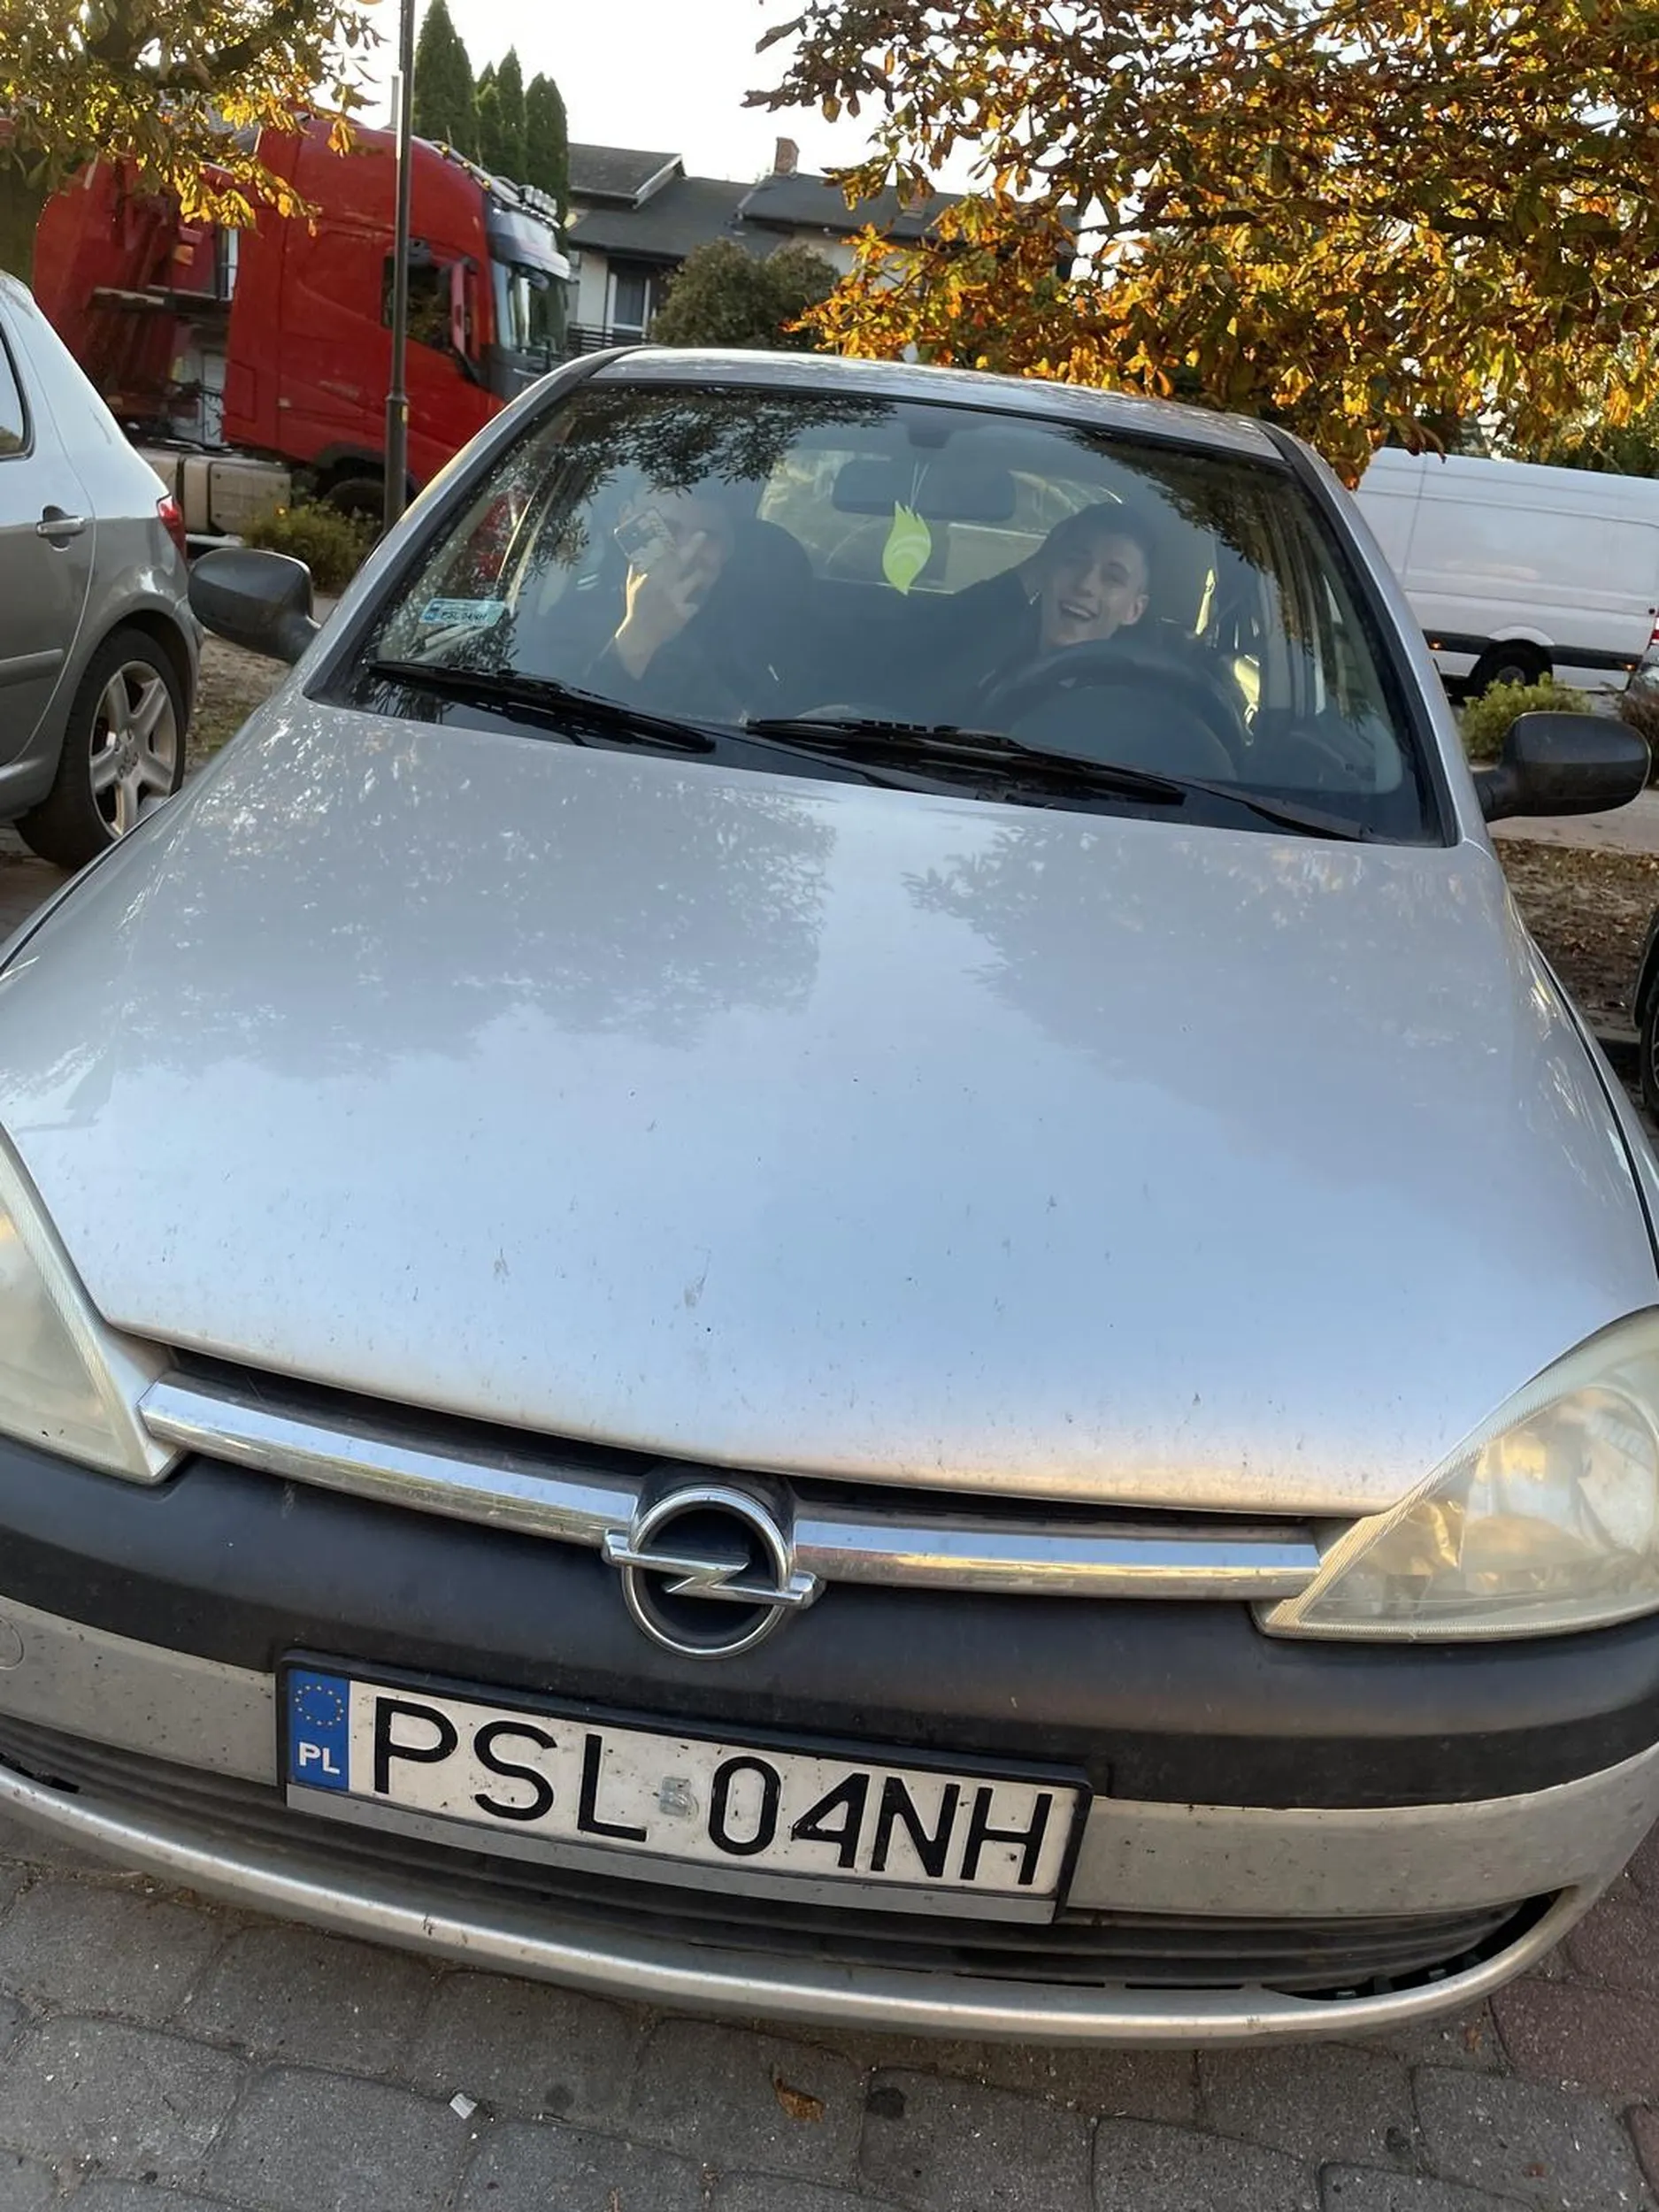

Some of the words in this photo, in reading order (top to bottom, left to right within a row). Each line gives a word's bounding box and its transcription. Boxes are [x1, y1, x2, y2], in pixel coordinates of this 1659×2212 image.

[298, 1742, 340, 1774] PL
[373, 1696, 647, 1842] PSL
[708, 1756, 1053, 1886] 04NH
